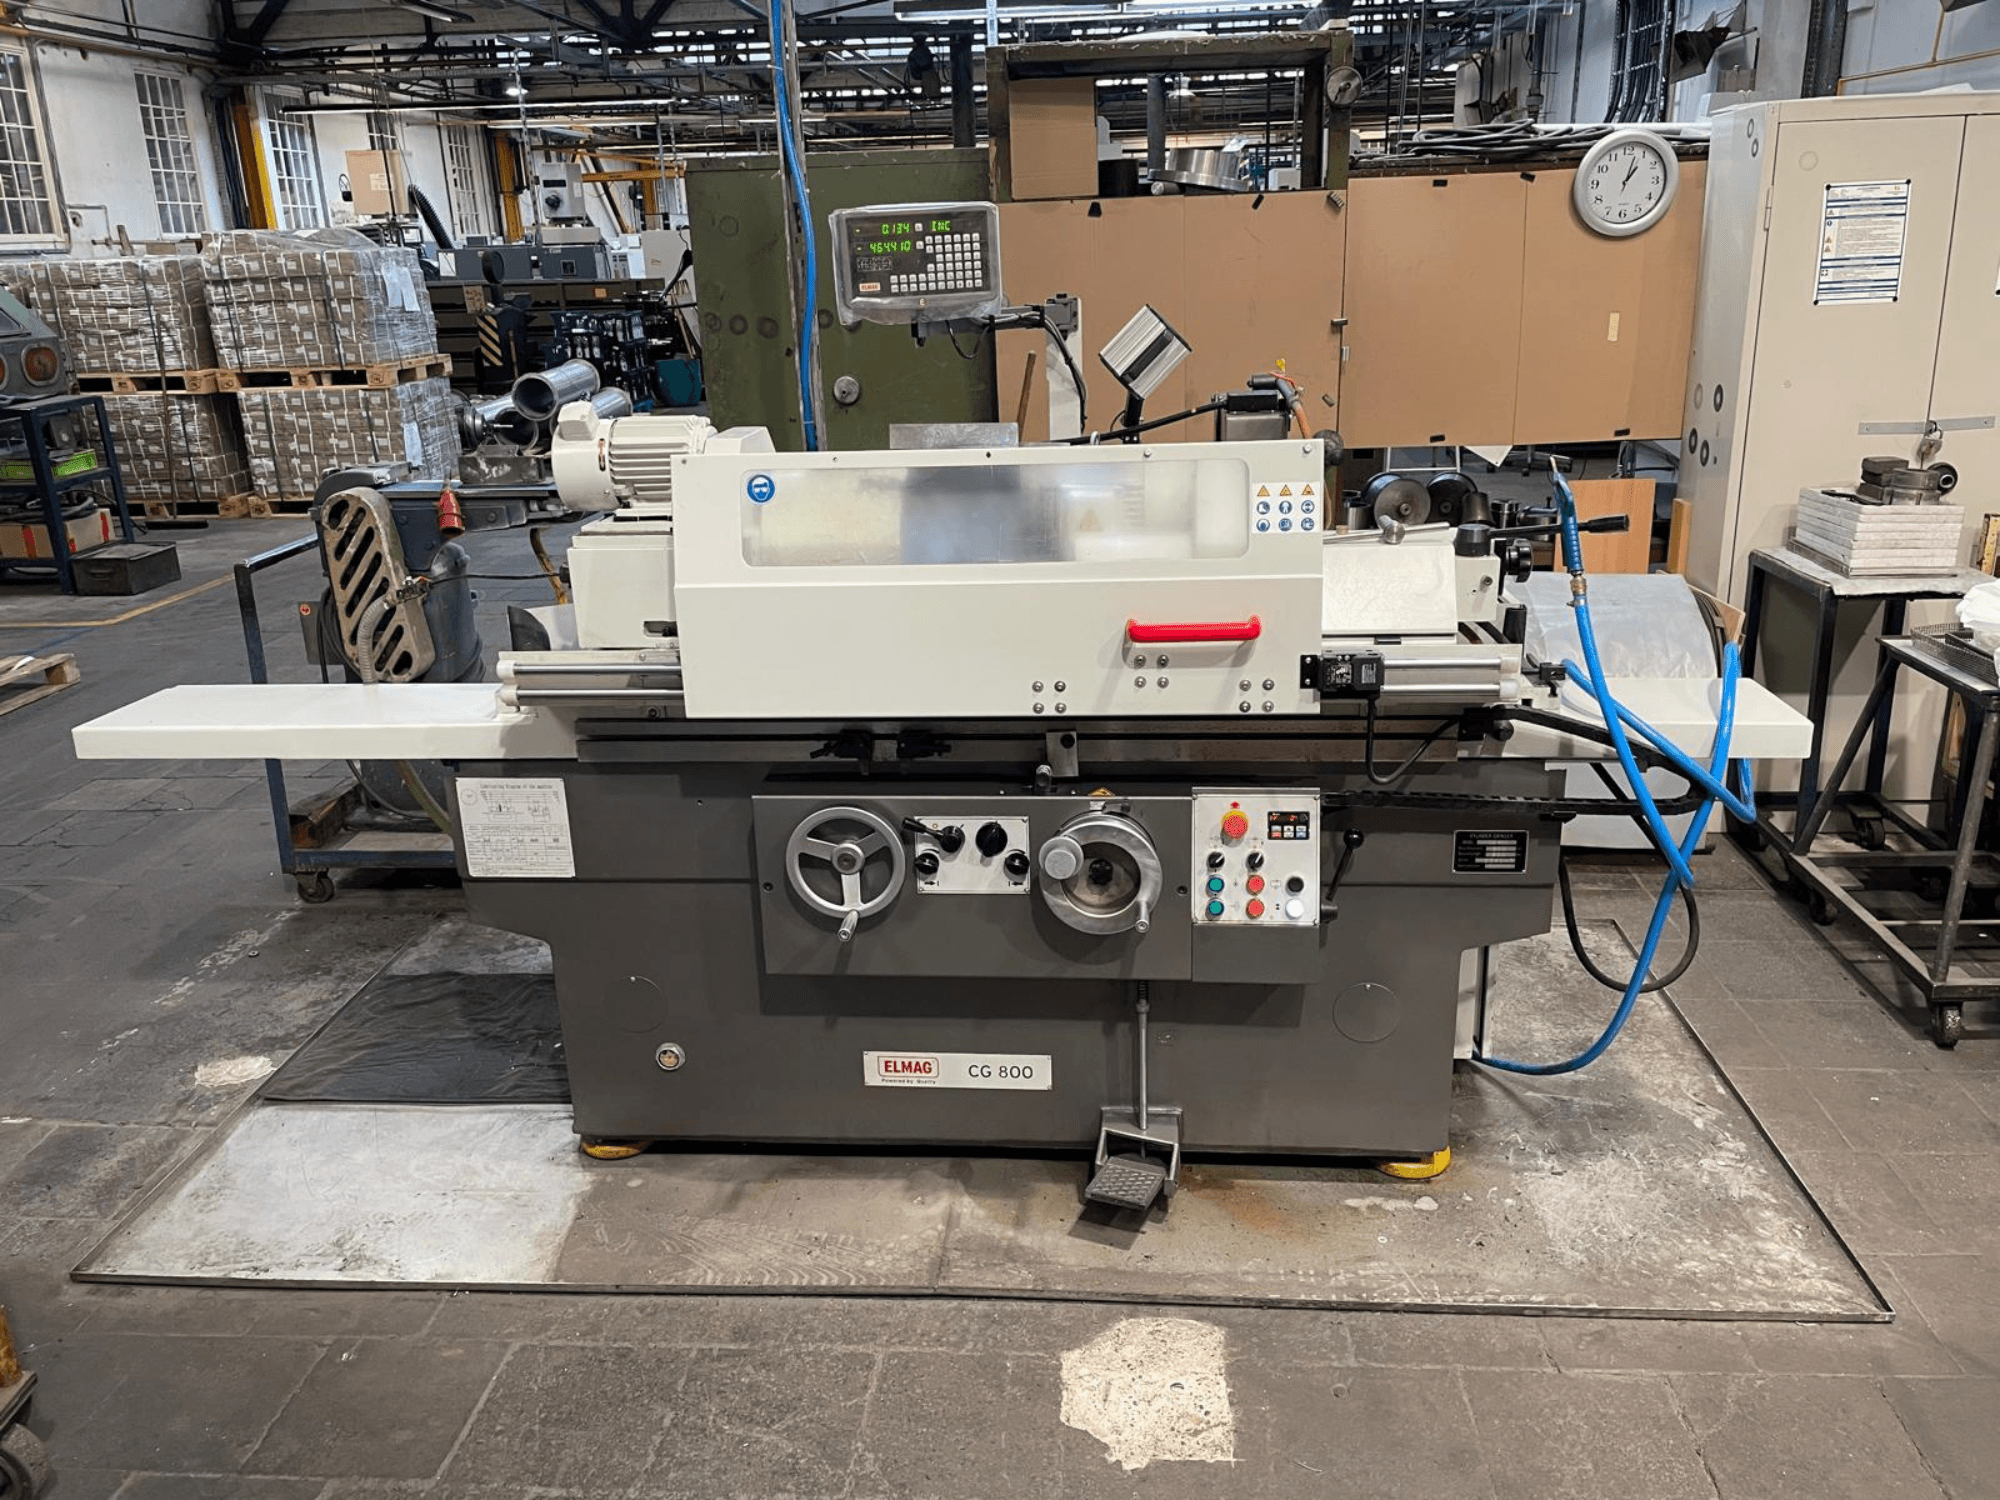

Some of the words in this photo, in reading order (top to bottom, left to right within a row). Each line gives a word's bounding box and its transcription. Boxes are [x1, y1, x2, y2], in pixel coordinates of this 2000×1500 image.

[1623, 146, 1635, 155] 12
[1642, 150, 1646, 158] 1
[1609, 153, 1618, 161] 11
[1597, 164, 1609, 173] 10
[1650, 161, 1657, 169] 2
[1590, 180, 1599, 189] 9
[1651, 176, 1660, 185] 3
[1594, 195, 1603, 205] 8
[1645, 192, 1652, 201] 4
[1605, 206, 1612, 216] 7
[1634, 204, 1642, 213] 5
[1618, 209, 1627, 218] 6
[884, 1060, 932, 1073] ELMAG
[968, 1064, 992, 1078] CG
[998, 1065, 1034, 1079] 800
